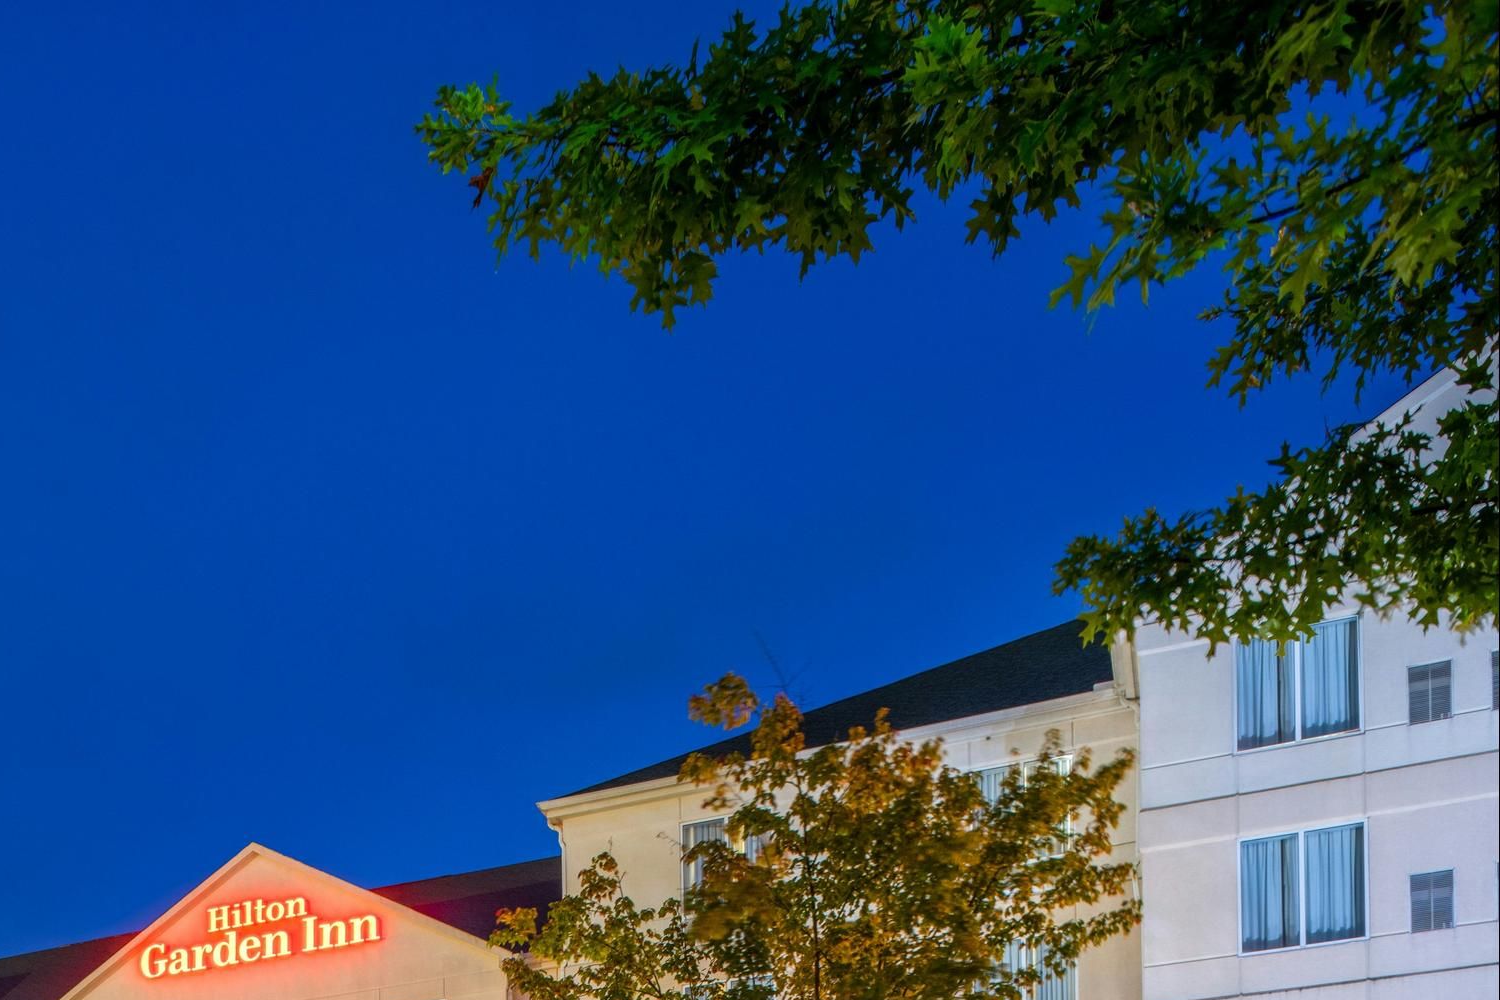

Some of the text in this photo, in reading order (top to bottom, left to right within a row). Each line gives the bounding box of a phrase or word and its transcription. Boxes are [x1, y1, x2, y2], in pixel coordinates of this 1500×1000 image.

[206, 896, 308, 933] Hilton
[140, 914, 381, 980] Garden Inn
